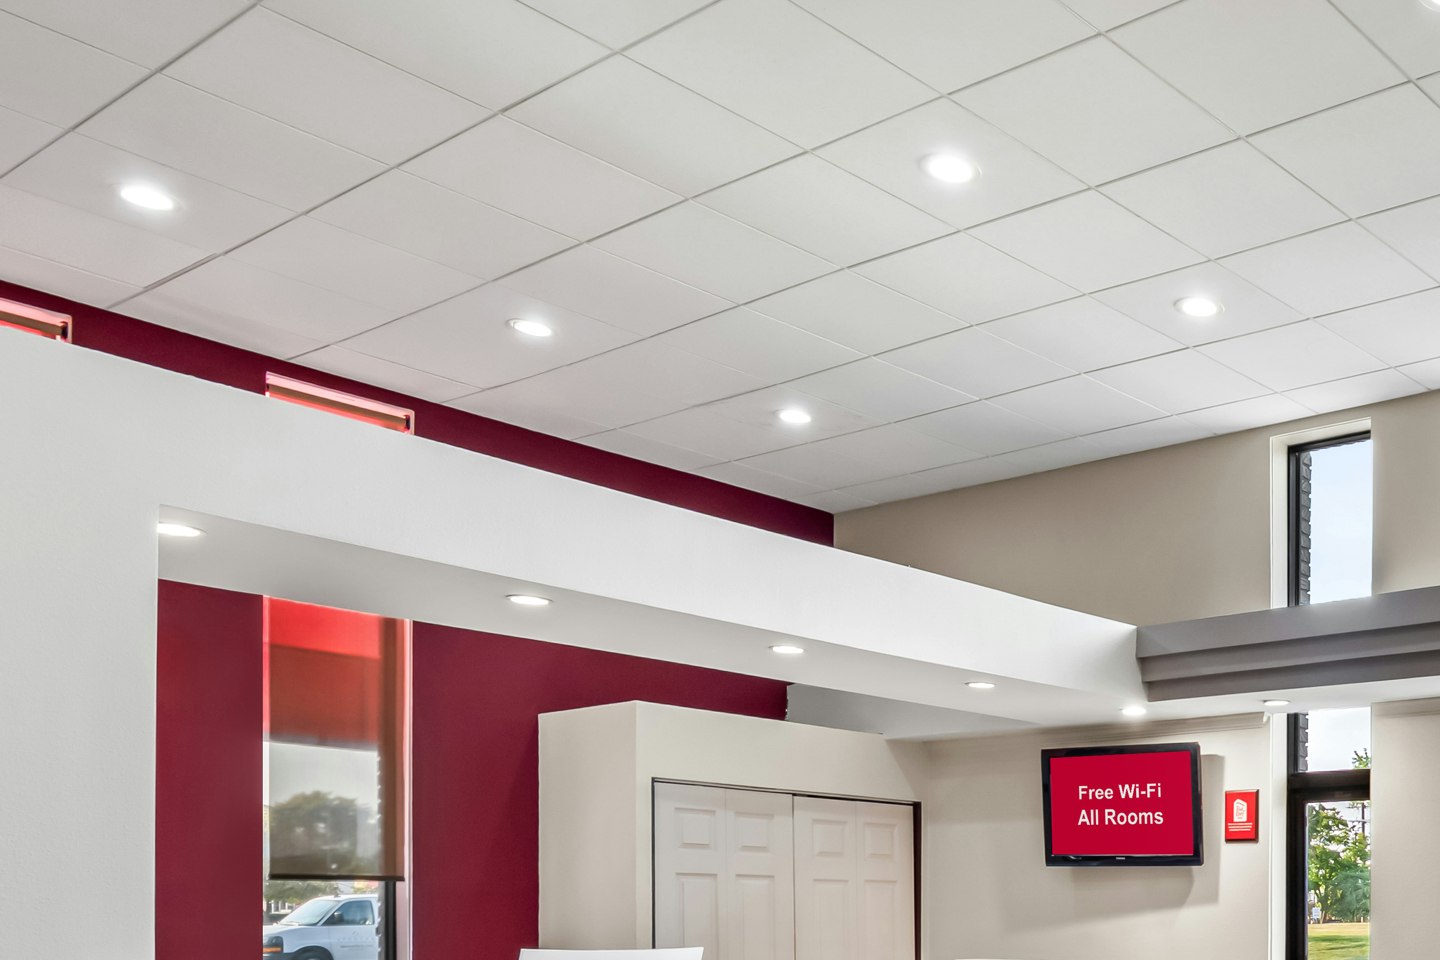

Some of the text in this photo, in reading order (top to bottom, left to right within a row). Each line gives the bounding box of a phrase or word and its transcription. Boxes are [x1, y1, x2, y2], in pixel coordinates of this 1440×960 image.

[1078, 782, 1162, 800] Free Wi-Fi
[1077, 808, 1164, 826] All Rooms
